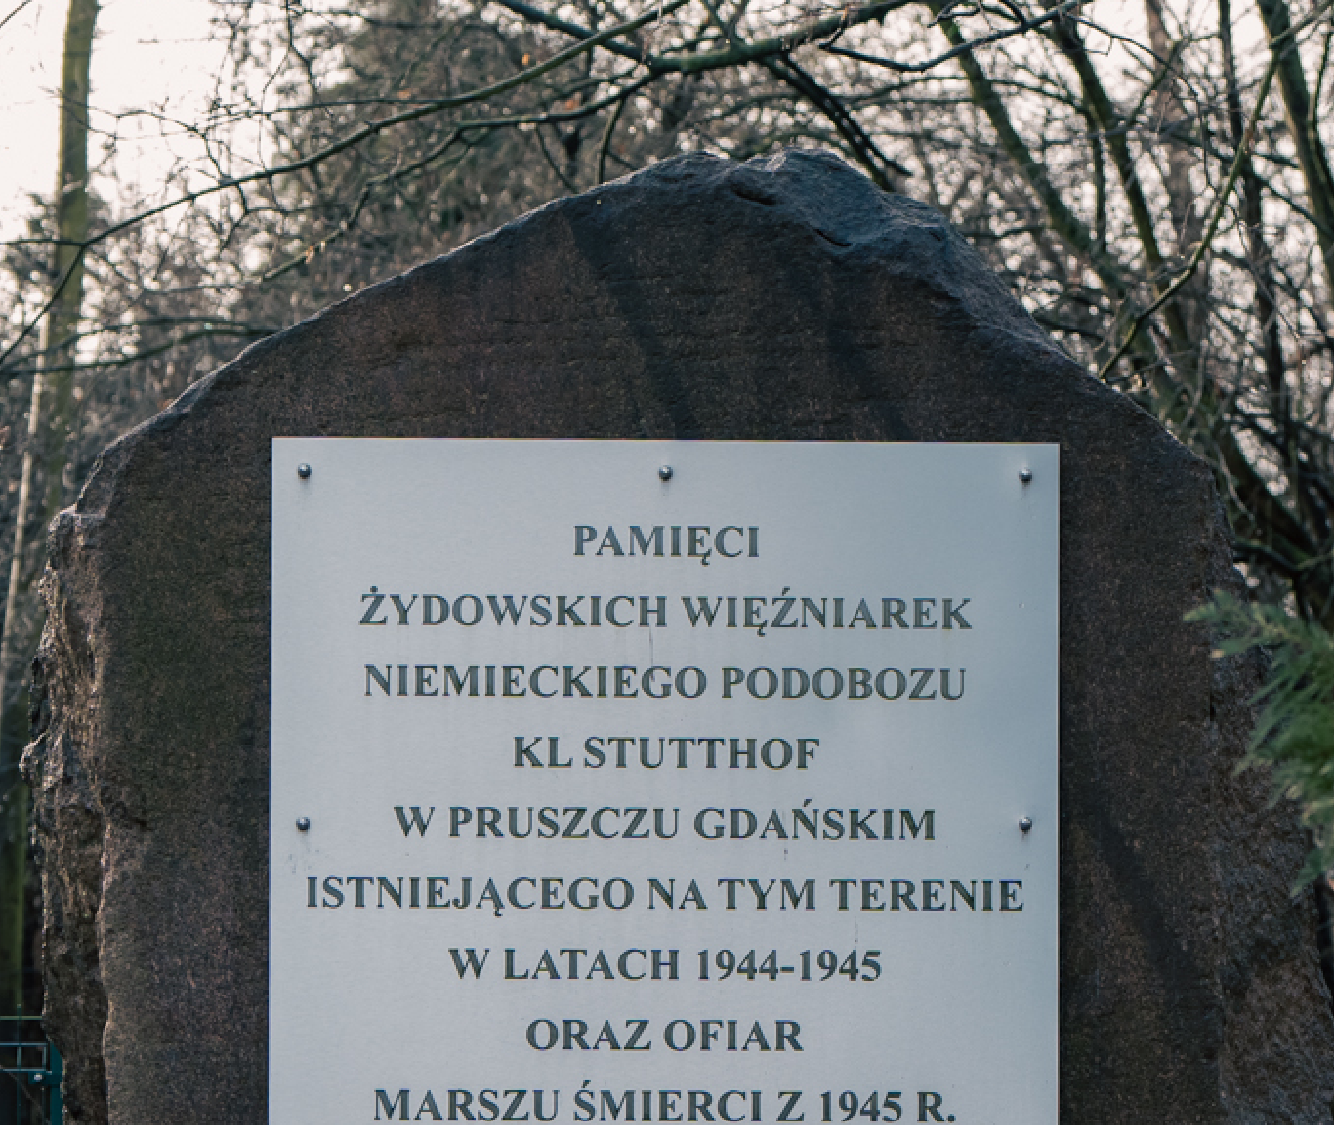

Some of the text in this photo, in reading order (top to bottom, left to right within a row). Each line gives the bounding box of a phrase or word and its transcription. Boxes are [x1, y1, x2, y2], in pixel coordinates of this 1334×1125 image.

[572, 525, 760, 565] PAMIĘCI
[359, 585, 973, 637] ŻYDOWSKICH WIĘŹNIAREK
[363, 663, 967, 701] NIEMIECKIEGO PODOBOZU
[514, 736, 820, 771] KL STUTTHOF
[394, 798, 937, 841] W PRUSZCZU GDAŃSKIM
[307, 874, 1025, 918] ISTNIEJĄCEGO NA TYM TERENIE
[447, 947, 883, 982] W LATACH 1944-1945
[525, 1019, 805, 1052] ORAZ OFIAR
[373, 1079, 957, 1124] MARSZU ŚMIERCI Z 1945 R.
